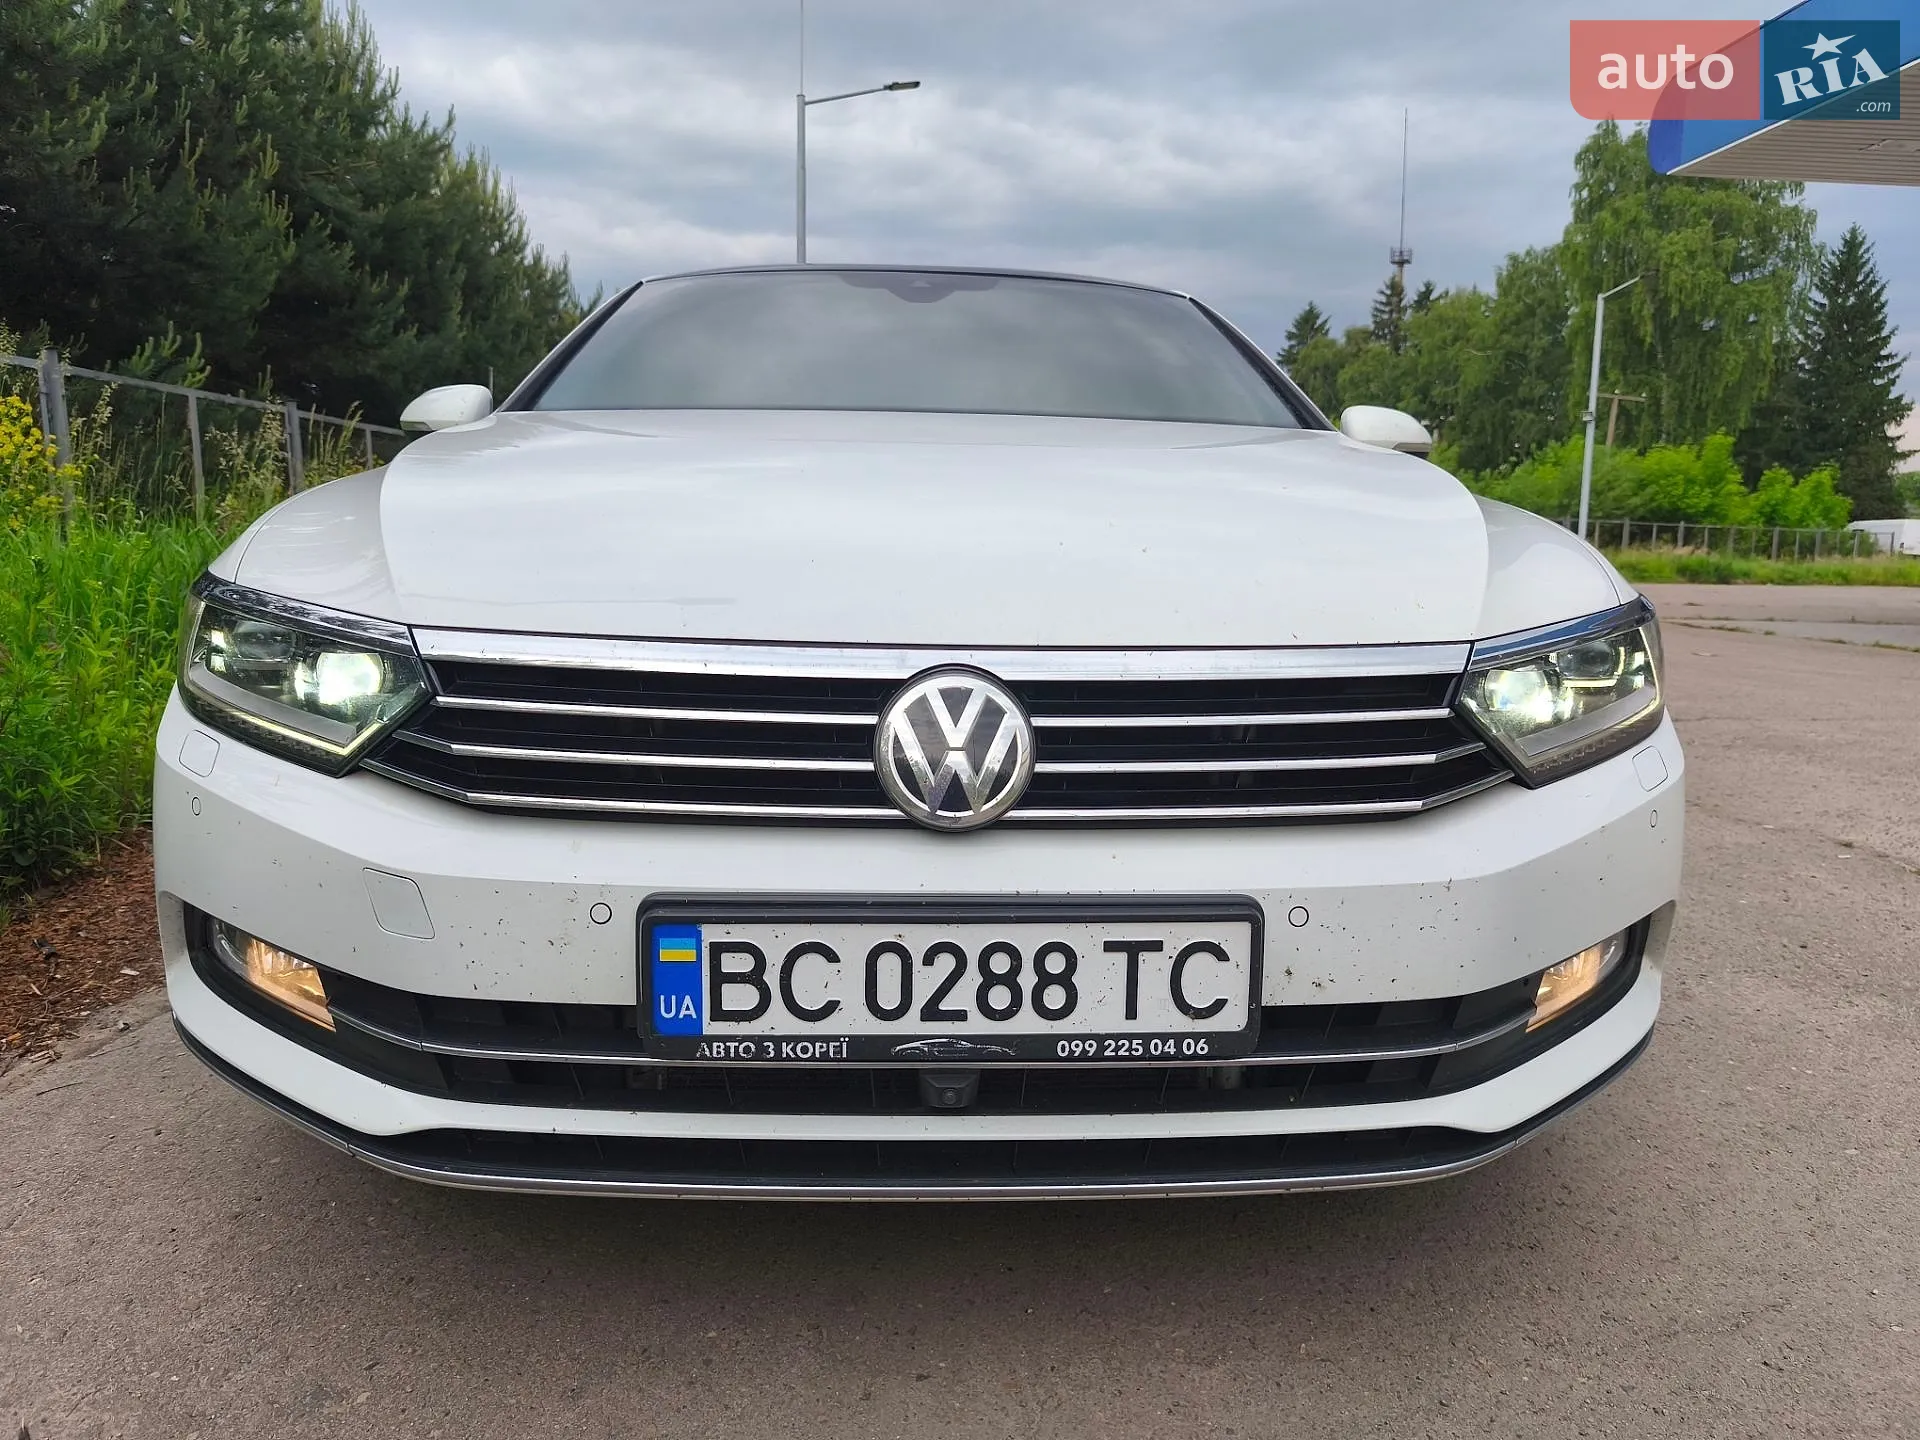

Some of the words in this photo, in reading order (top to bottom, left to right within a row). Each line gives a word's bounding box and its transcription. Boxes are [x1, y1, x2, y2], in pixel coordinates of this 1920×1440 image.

[659, 994, 697, 1019] UA
[697, 1041, 756, 1059] АВТО
[1056, 1039, 1097, 1057] 099
[1103, 1039, 1144, 1057] 225
[1149, 1038, 1176, 1056] 04
[1182, 1038, 1209, 1056] 06
